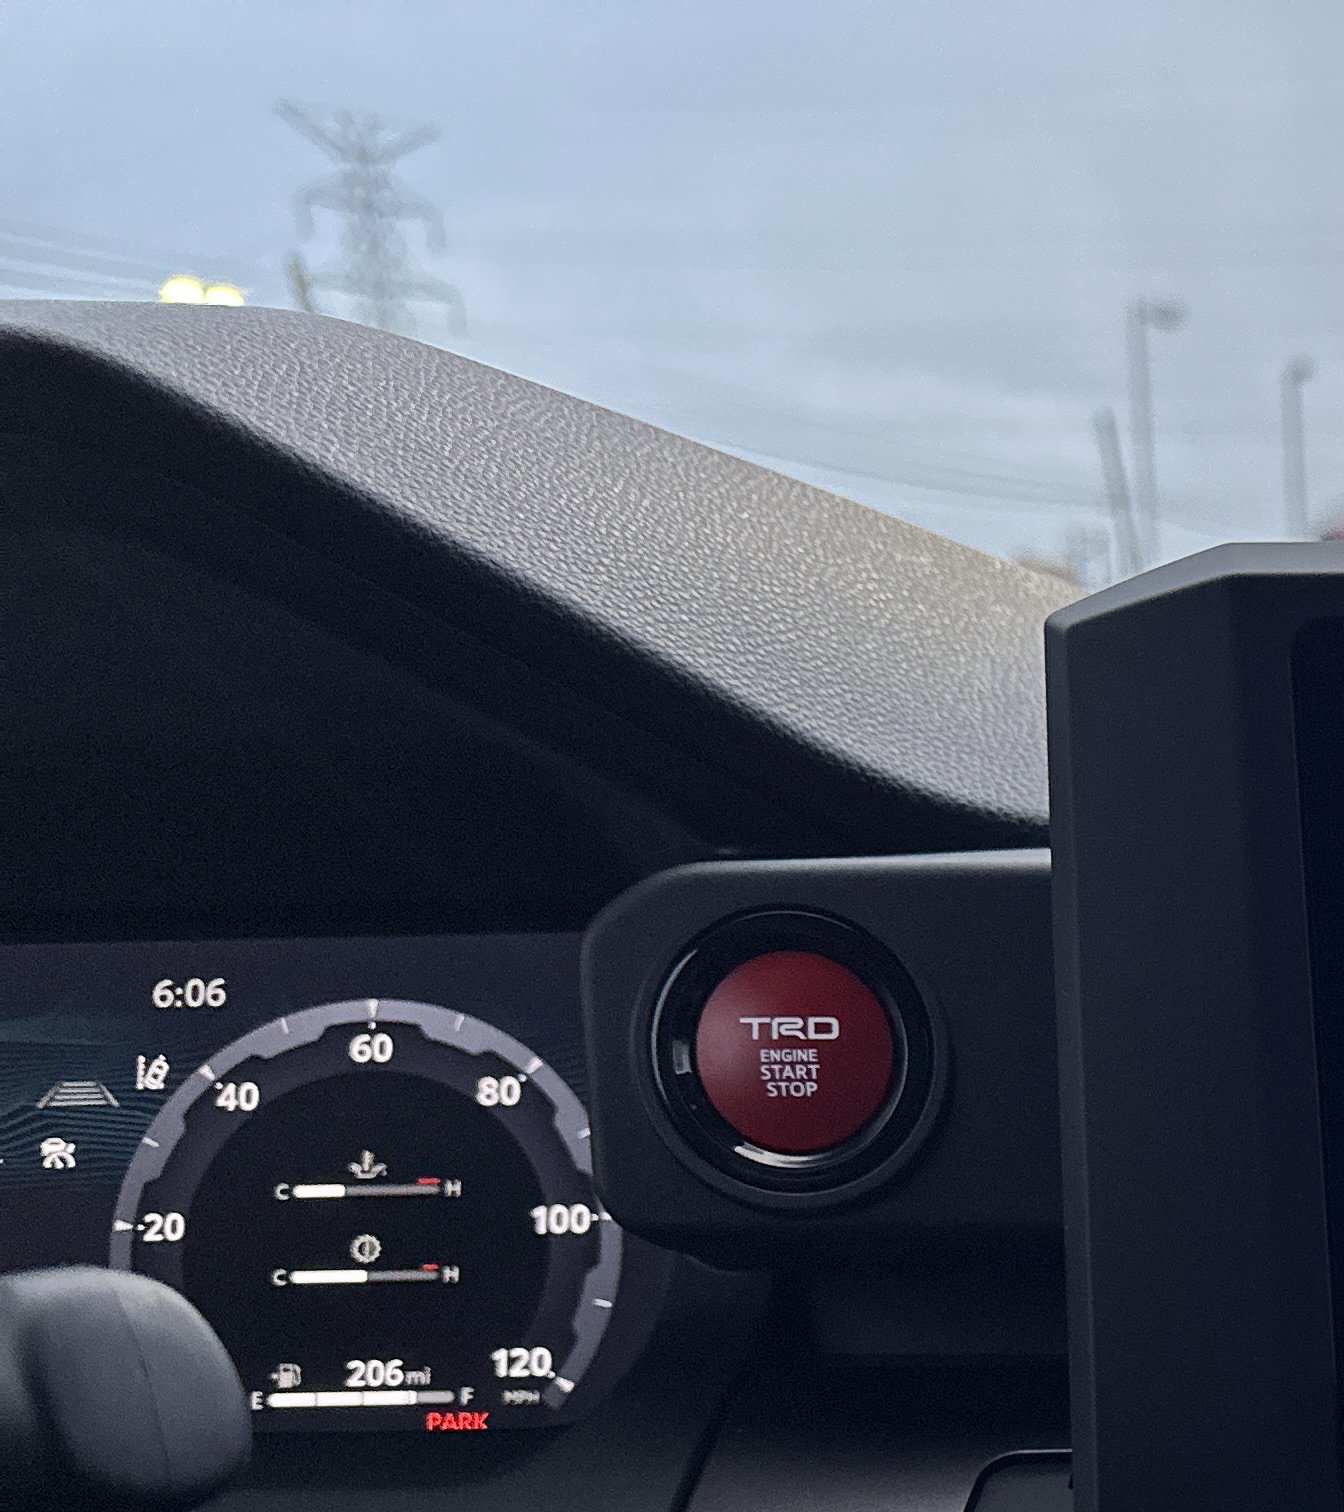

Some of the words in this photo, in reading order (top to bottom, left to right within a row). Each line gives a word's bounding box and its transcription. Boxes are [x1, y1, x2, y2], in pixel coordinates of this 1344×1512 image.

[152, 978, 227, 1008] 6:06
[739, 1016, 840, 1040] TRD
[349, 1033, 393, 1063] 60
[760, 1048, 818, 1063] ENGINE
[760, 1064, 820, 1080] START
[216, 1081, 259, 1111] 40
[476, 1076, 521, 1106] 80
[766, 1081, 818, 1098] STOP
[444, 1179, 462, 1198] H
[143, 1212, 186, 1242] 20
[530, 1203, 591, 1235] 100
[442, 1265, 460, 1284] H
[491, 1347, 552, 1378] 120
[251, 1391, 264, 1411] E
[460, 1386, 474, 1406] F
[425, 1411, 489, 1431] PARK
